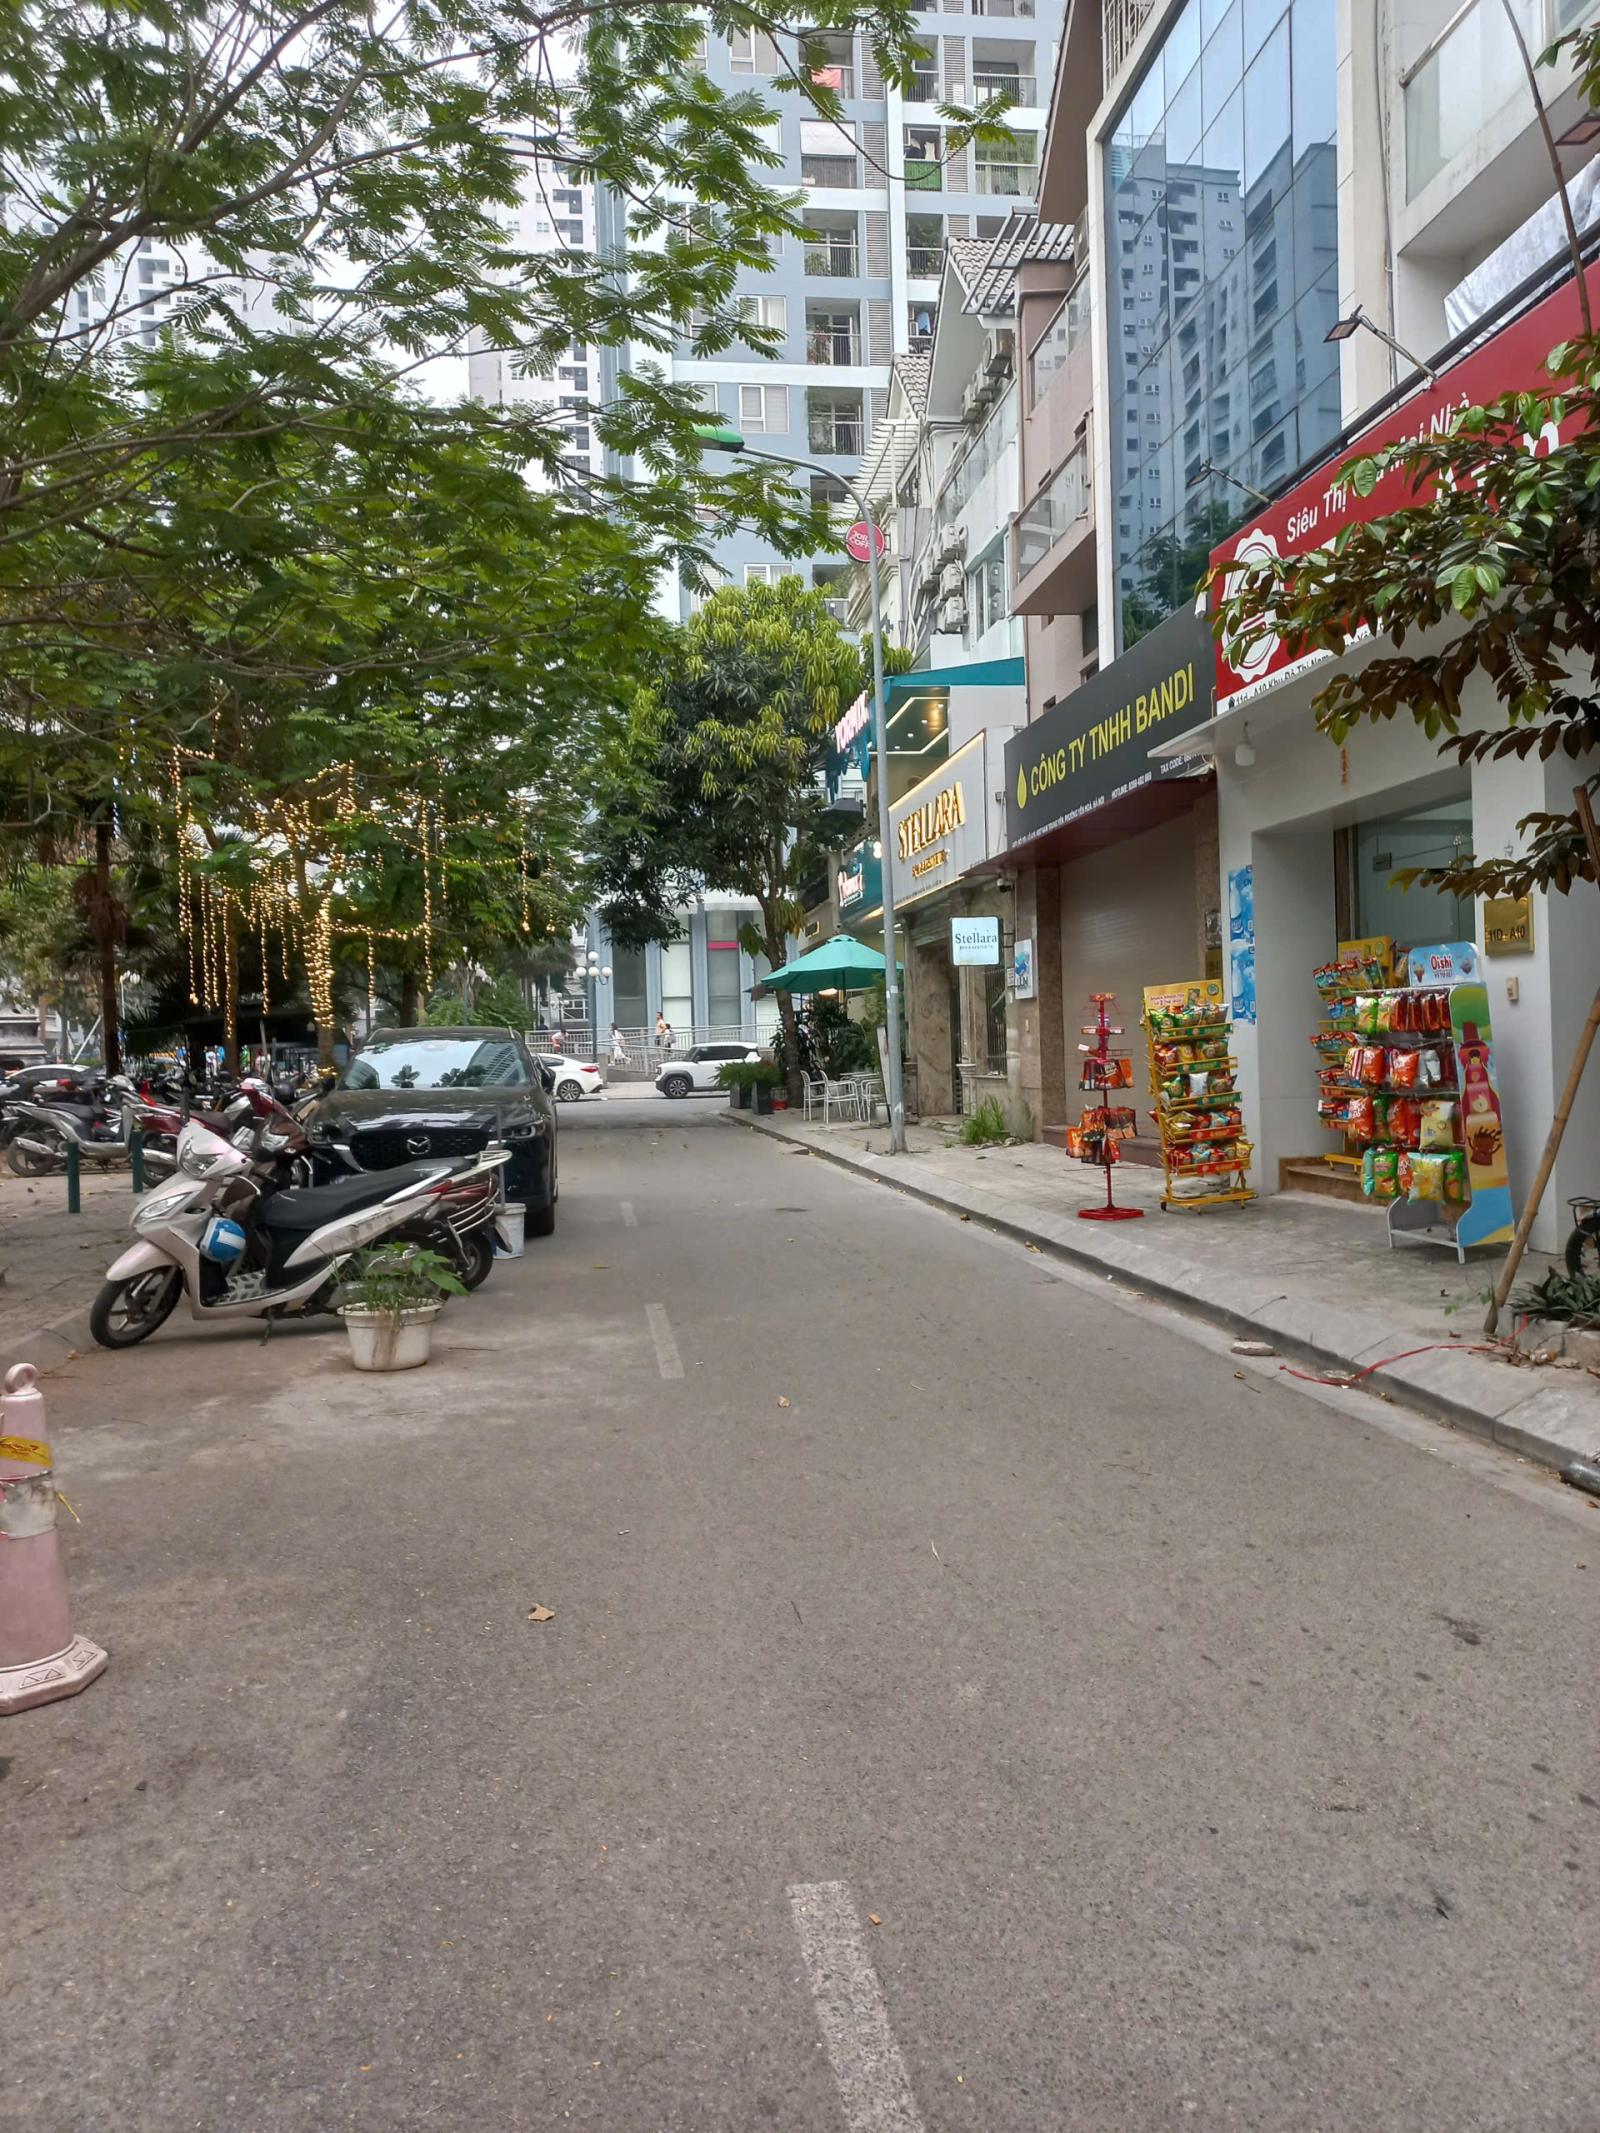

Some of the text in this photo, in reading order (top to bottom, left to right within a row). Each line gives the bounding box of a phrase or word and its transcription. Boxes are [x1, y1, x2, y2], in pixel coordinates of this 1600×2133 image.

[1286, 485, 1347, 542] Siêu Thị
[1030, 662, 1194, 796] CÔNG TY TNHH BANDI
[898, 780, 966, 863] STELLARA
[954, 932, 998, 945] Stellara
[1430, 954, 1453, 971] Oishi
